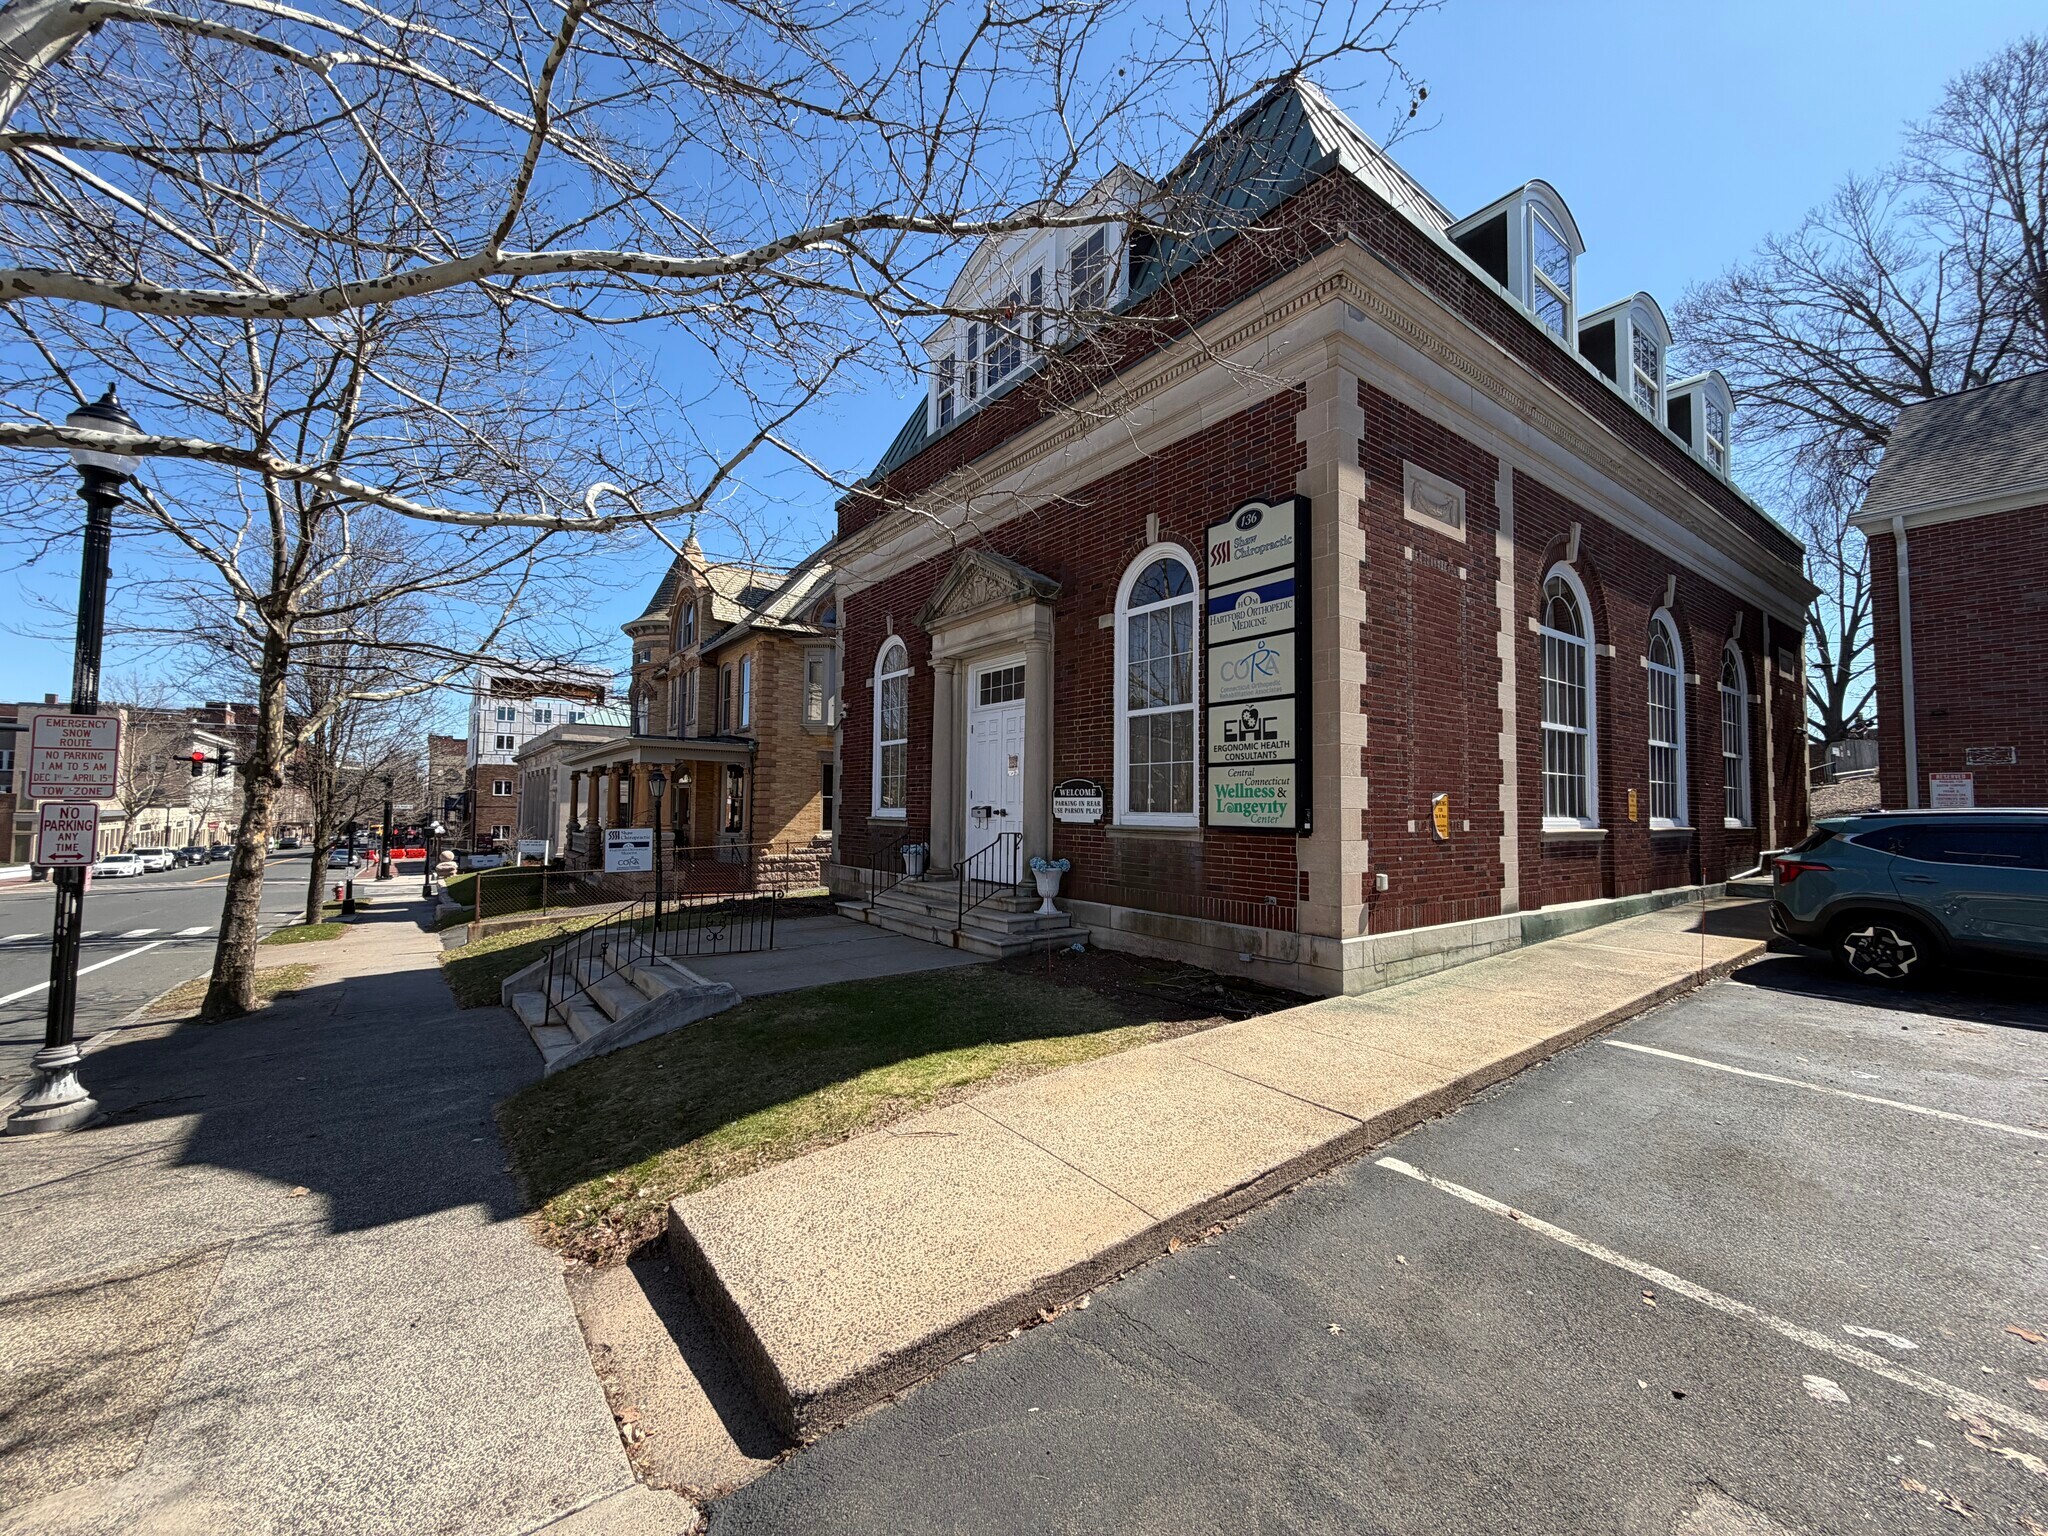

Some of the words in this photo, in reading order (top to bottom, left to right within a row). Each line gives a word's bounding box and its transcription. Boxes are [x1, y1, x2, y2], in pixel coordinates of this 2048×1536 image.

[1241, 512, 1257, 527] 136
[1234, 534, 1257, 548] Shaw
[1234, 534, 1292, 560] Chiropractic
[1210, 611, 1245, 625] HARTFORD
[1247, 600, 1293, 617] ORTHOPEDIC
[1232, 617, 1267, 631] MEDICINE
[1220, 649, 1280, 682] CORA
[46, 719, 107, 728] EMERGENCY
[62, 729, 91, 737] SNOW
[1224, 716, 1277, 742] EHC
[60, 739, 92, 747] ROUTE
[1214, 742, 1258, 752] ERGONOMIC
[1260, 740, 1290, 749] HEALTH
[46, 751, 59, 759] NO
[64, 752, 104, 760] PARKING
[1225, 751, 1277, 761] CONSULTANTS
[41, 762, 44, 770] 1
[48, 762, 62, 770] AM
[93, 763, 106, 771] AM
[1228, 768, 1255, 777] Central
[72, 774, 96, 782] APRIL
[1245, 776, 1290, 786] Connecticut
[42, 787, 64, 795] TOW
[74, 787, 103, 795] ZONE
[1214, 783, 1275, 798] Wellness
[1277, 787, 1287, 798] &
[60, 808, 80, 819] NO
[1250, 814, 1279, 824] Center
[44, 820, 92, 831] PARKING
